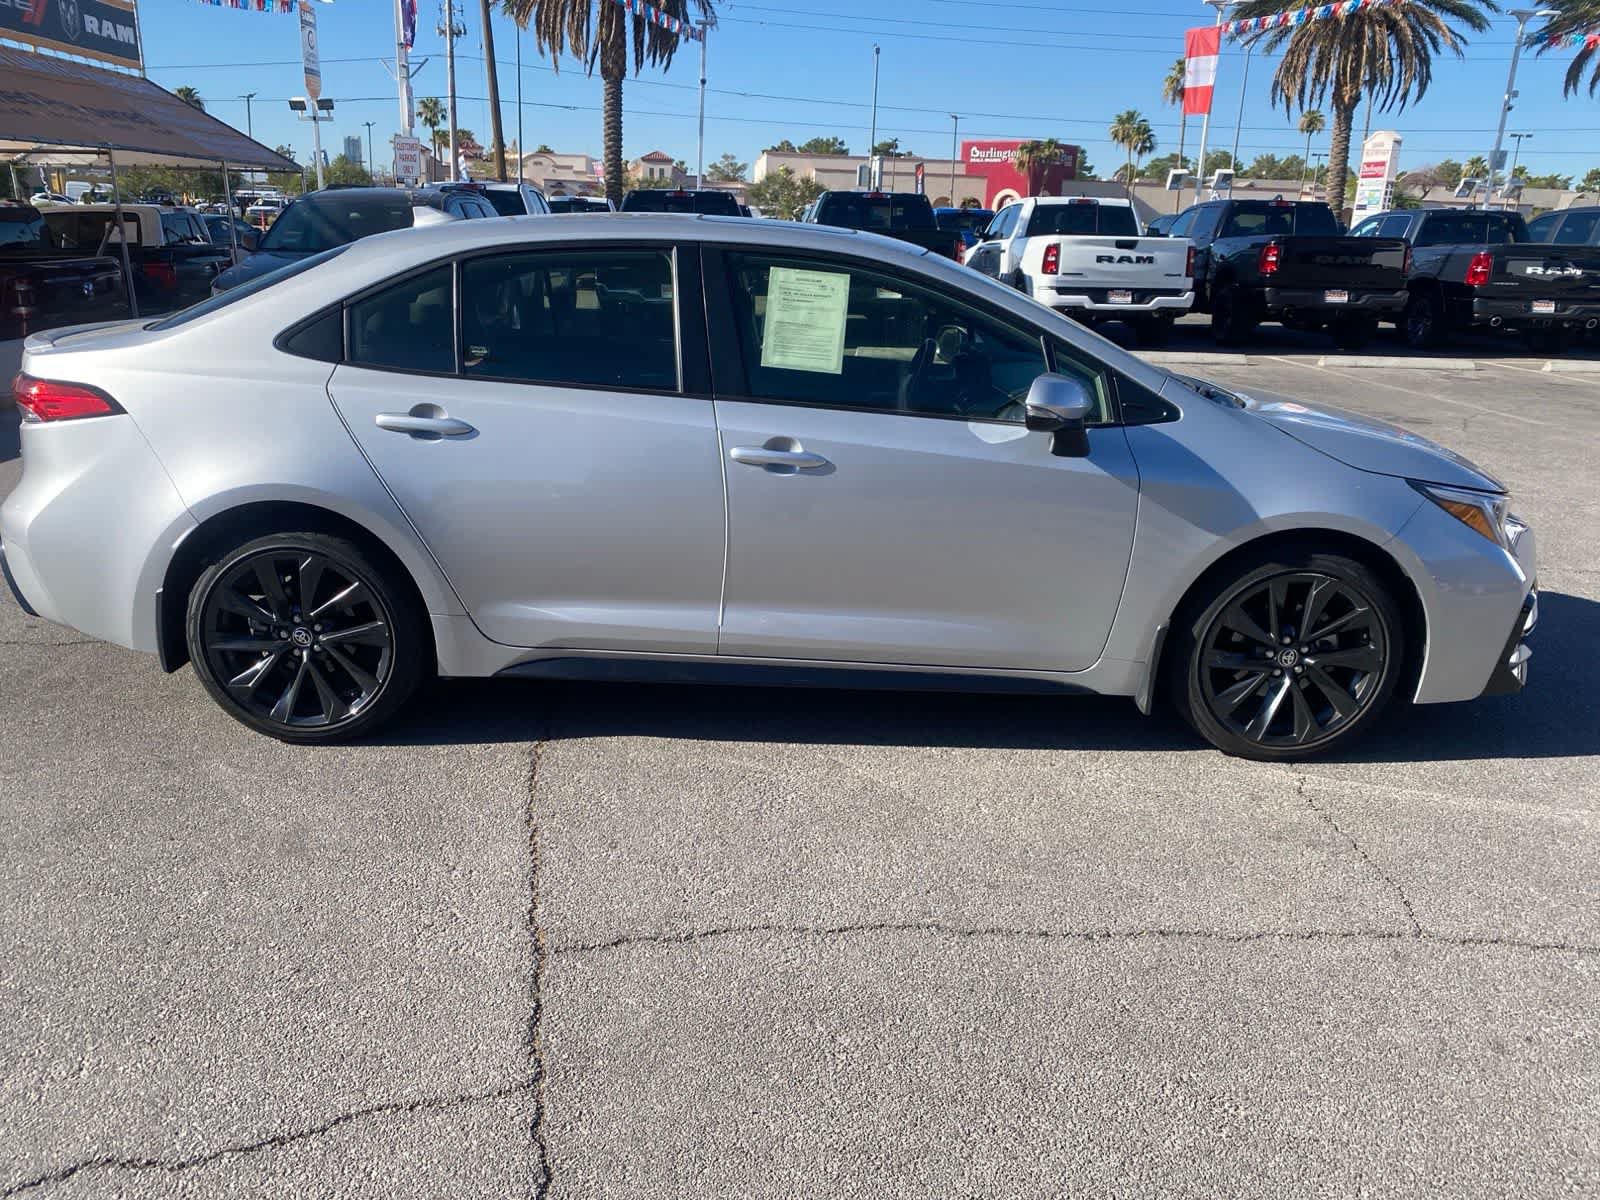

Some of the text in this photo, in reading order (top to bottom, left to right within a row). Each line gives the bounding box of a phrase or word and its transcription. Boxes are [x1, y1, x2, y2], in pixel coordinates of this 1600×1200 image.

[83, 14, 136, 44] RAM
[399, 152, 417, 162] PARKING
[1095, 255, 1155, 264] RAM
[1525, 266, 1583, 275] RAM
